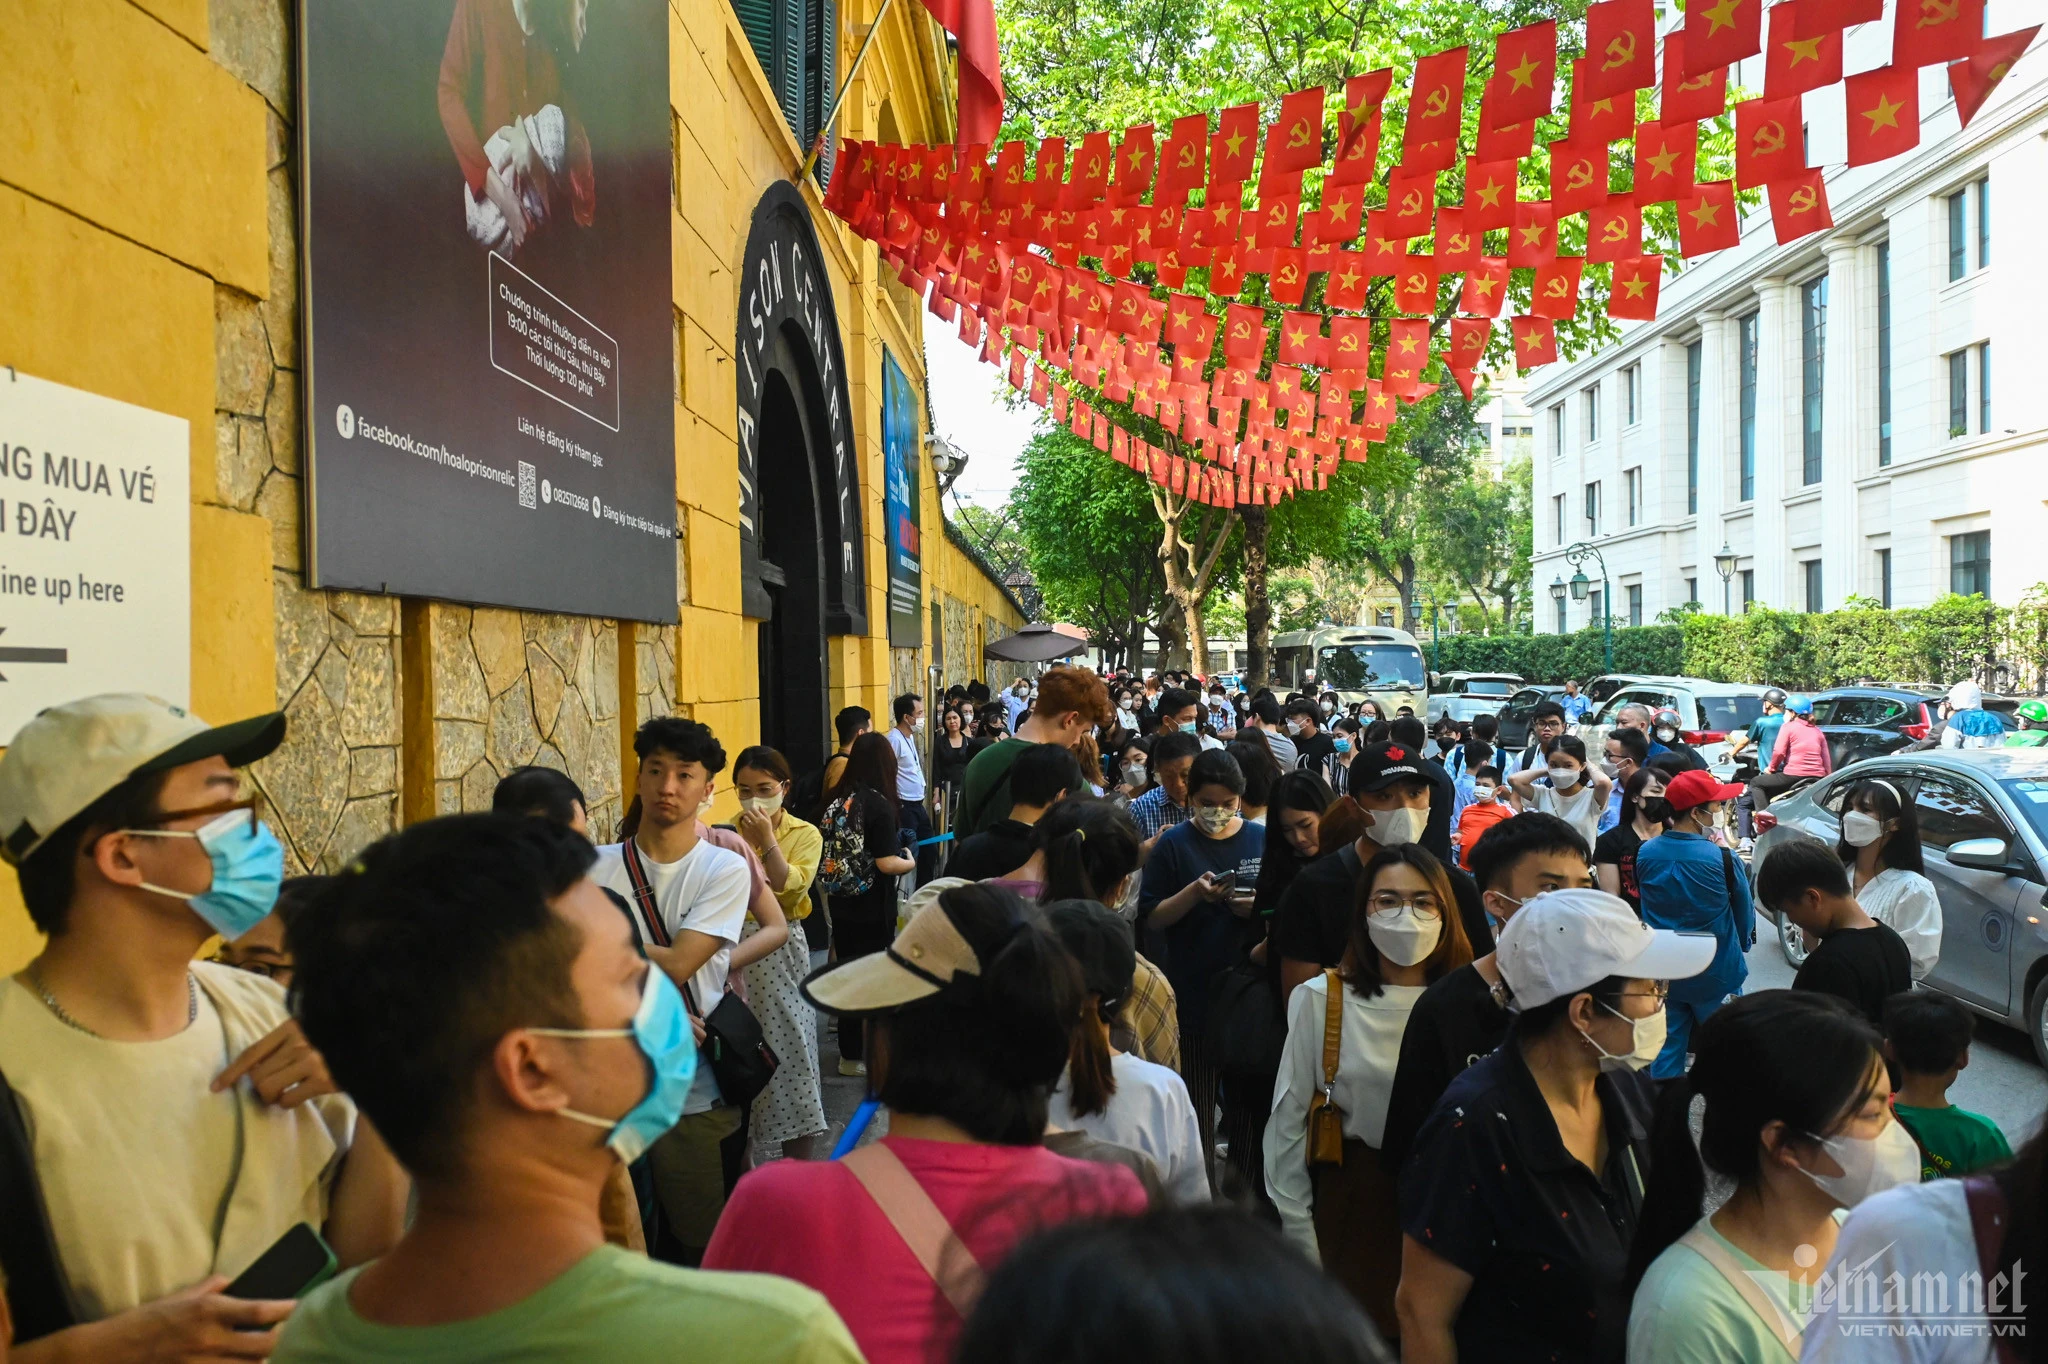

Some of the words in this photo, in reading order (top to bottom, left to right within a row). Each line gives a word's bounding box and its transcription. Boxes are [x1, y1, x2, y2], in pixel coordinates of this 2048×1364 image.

[499, 283, 531, 319] Chương
[533, 306, 551, 329] trình
[593, 349, 600, 362] ra
[507, 310, 528, 336] 19:00
[529, 328, 542, 346] các
[526, 345, 542, 366] Thời
[566, 369, 577, 388] 120
[792, 241, 853, 574] CENTRALE
[357, 416, 516, 488] facebook.com/hoaloprisonrelic
[518, 416, 535, 437] Liên
[536, 423, 545, 445] hệ
[546, 430, 565, 453] đăng
[565, 438, 574, 457] ký
[574, 443, 592, 462] tham
[44, 452, 112, 496] MUA
[120, 465, 154, 504] VÉ
[16, 497, 77, 542] ĐÂY
[44, 577, 71, 605] up
[78, 573, 124, 603] here
